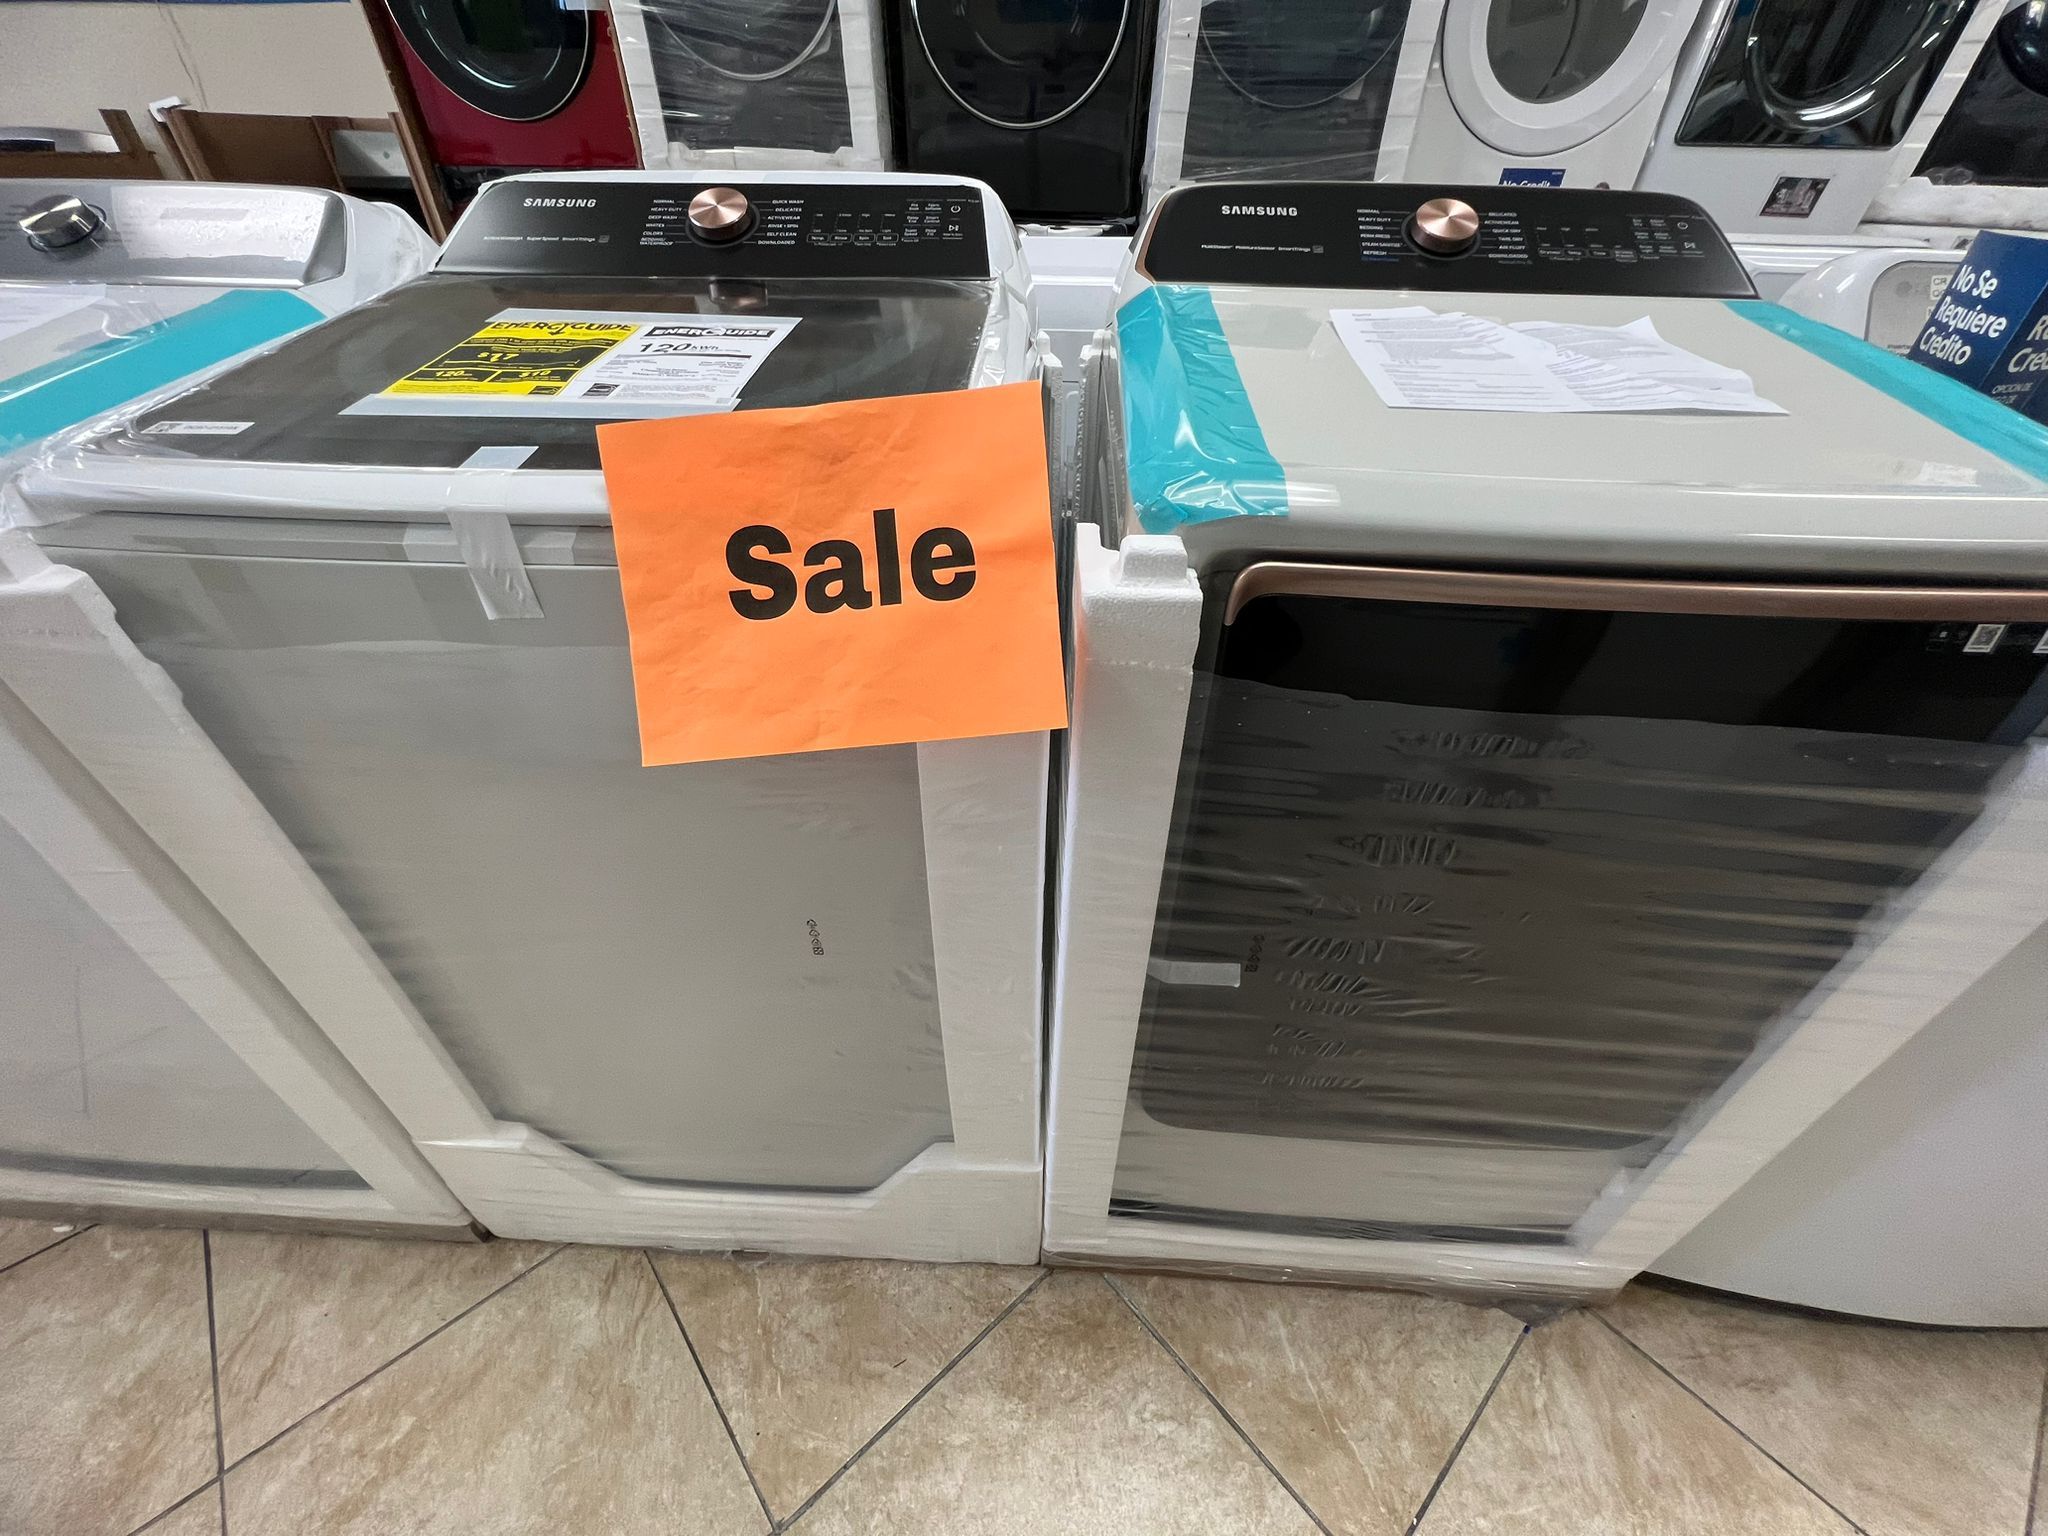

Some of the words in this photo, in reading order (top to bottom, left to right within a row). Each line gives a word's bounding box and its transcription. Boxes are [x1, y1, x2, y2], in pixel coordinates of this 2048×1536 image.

[523, 198, 597, 208] SAMSUNG
[1221, 204, 1299, 217] SAMSUNG
[1951, 264, 1976, 293] No
[1971, 269, 1998, 299] Se
[1934, 295, 2008, 338] Requiere
[640, 342, 692, 354] 120
[1919, 326, 1972, 365] Crédito
[725, 508, 977, 620] Sale
